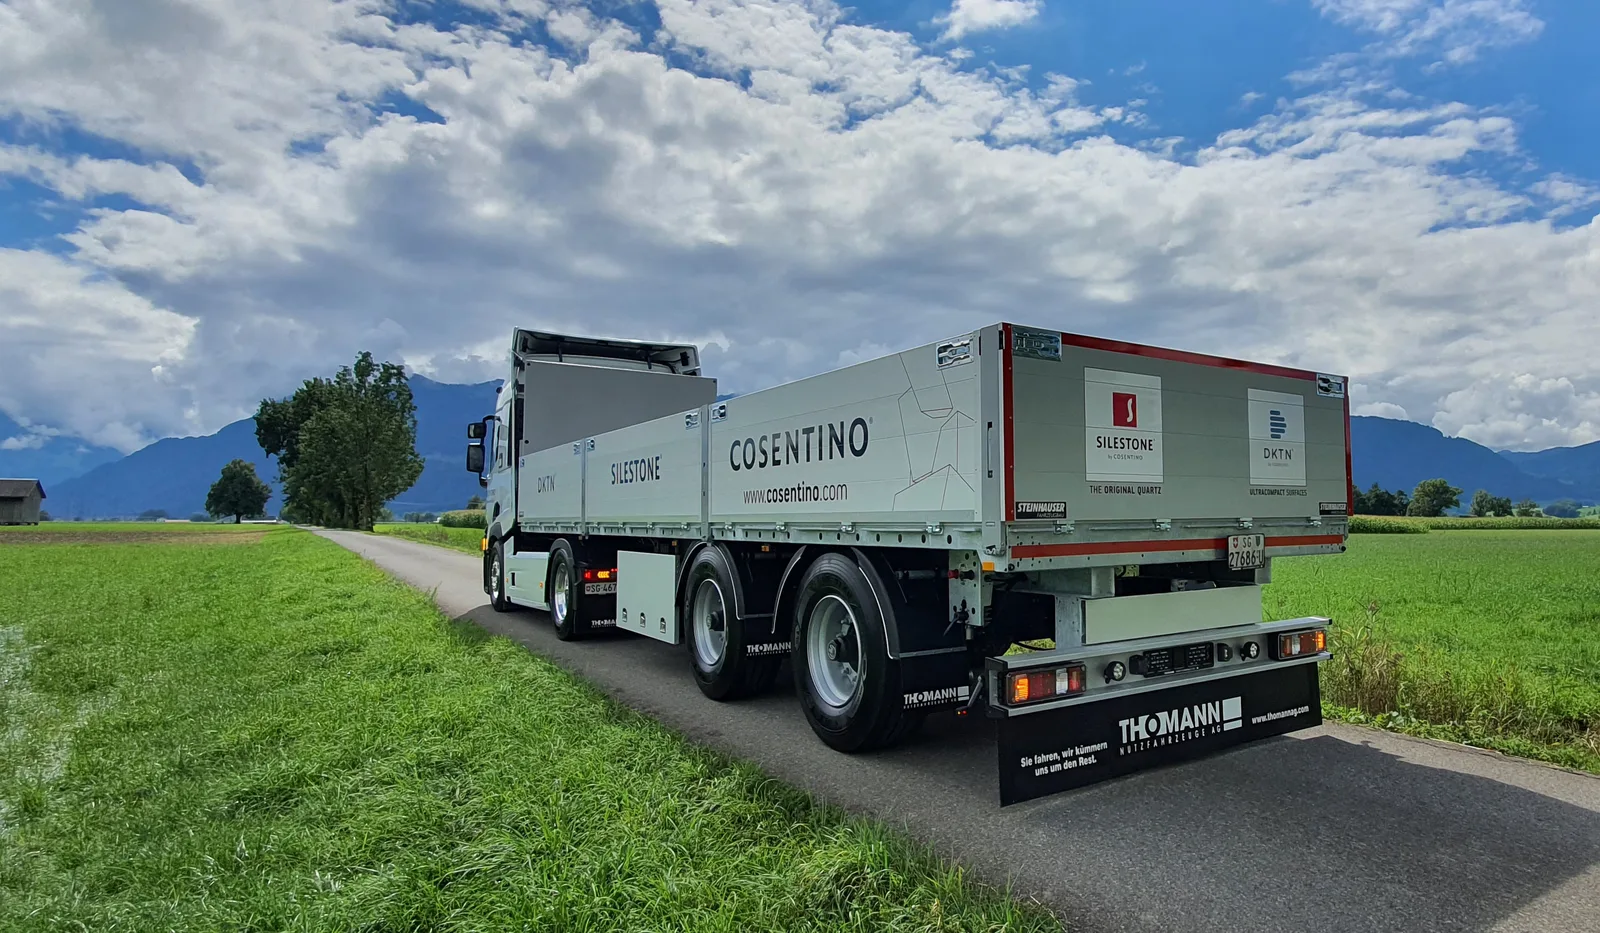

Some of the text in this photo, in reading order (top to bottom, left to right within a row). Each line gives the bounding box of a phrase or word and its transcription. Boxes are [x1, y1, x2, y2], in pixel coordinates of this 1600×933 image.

[729, 417, 869, 472] COSENTINO
[1096, 435, 1154, 451] SILESTONE
[1113, 453, 1143, 461] COSENTINO
[1263, 447, 1292, 460] DKTN
[611, 455, 661, 486] SILESTONE
[537, 475, 556, 494] DKTN
[743, 480, 848, 504] www.cosentino.com
[1089, 485, 1162, 496] THE ORIGINAL QUARTZ
[1249, 488, 1308, 497] ULTRACOMPACT SURFACES
[1017, 502, 1066, 513] STEINHAUSER
[1242, 536, 1252, 548] SG
[746, 641, 792, 654] THOMANN
[903, 686, 957, 705] THOMANN
[1118, 700, 1221, 744] THOMANN
[1251, 705, 1310, 725] www.thomannag.com
[1119, 724, 1222, 756] NUTZFAHRZEUGE AG
[1020, 741, 1108, 768] Sie fahren, wir kümmern
[1034, 754, 1097, 777] uns um den Rest.
